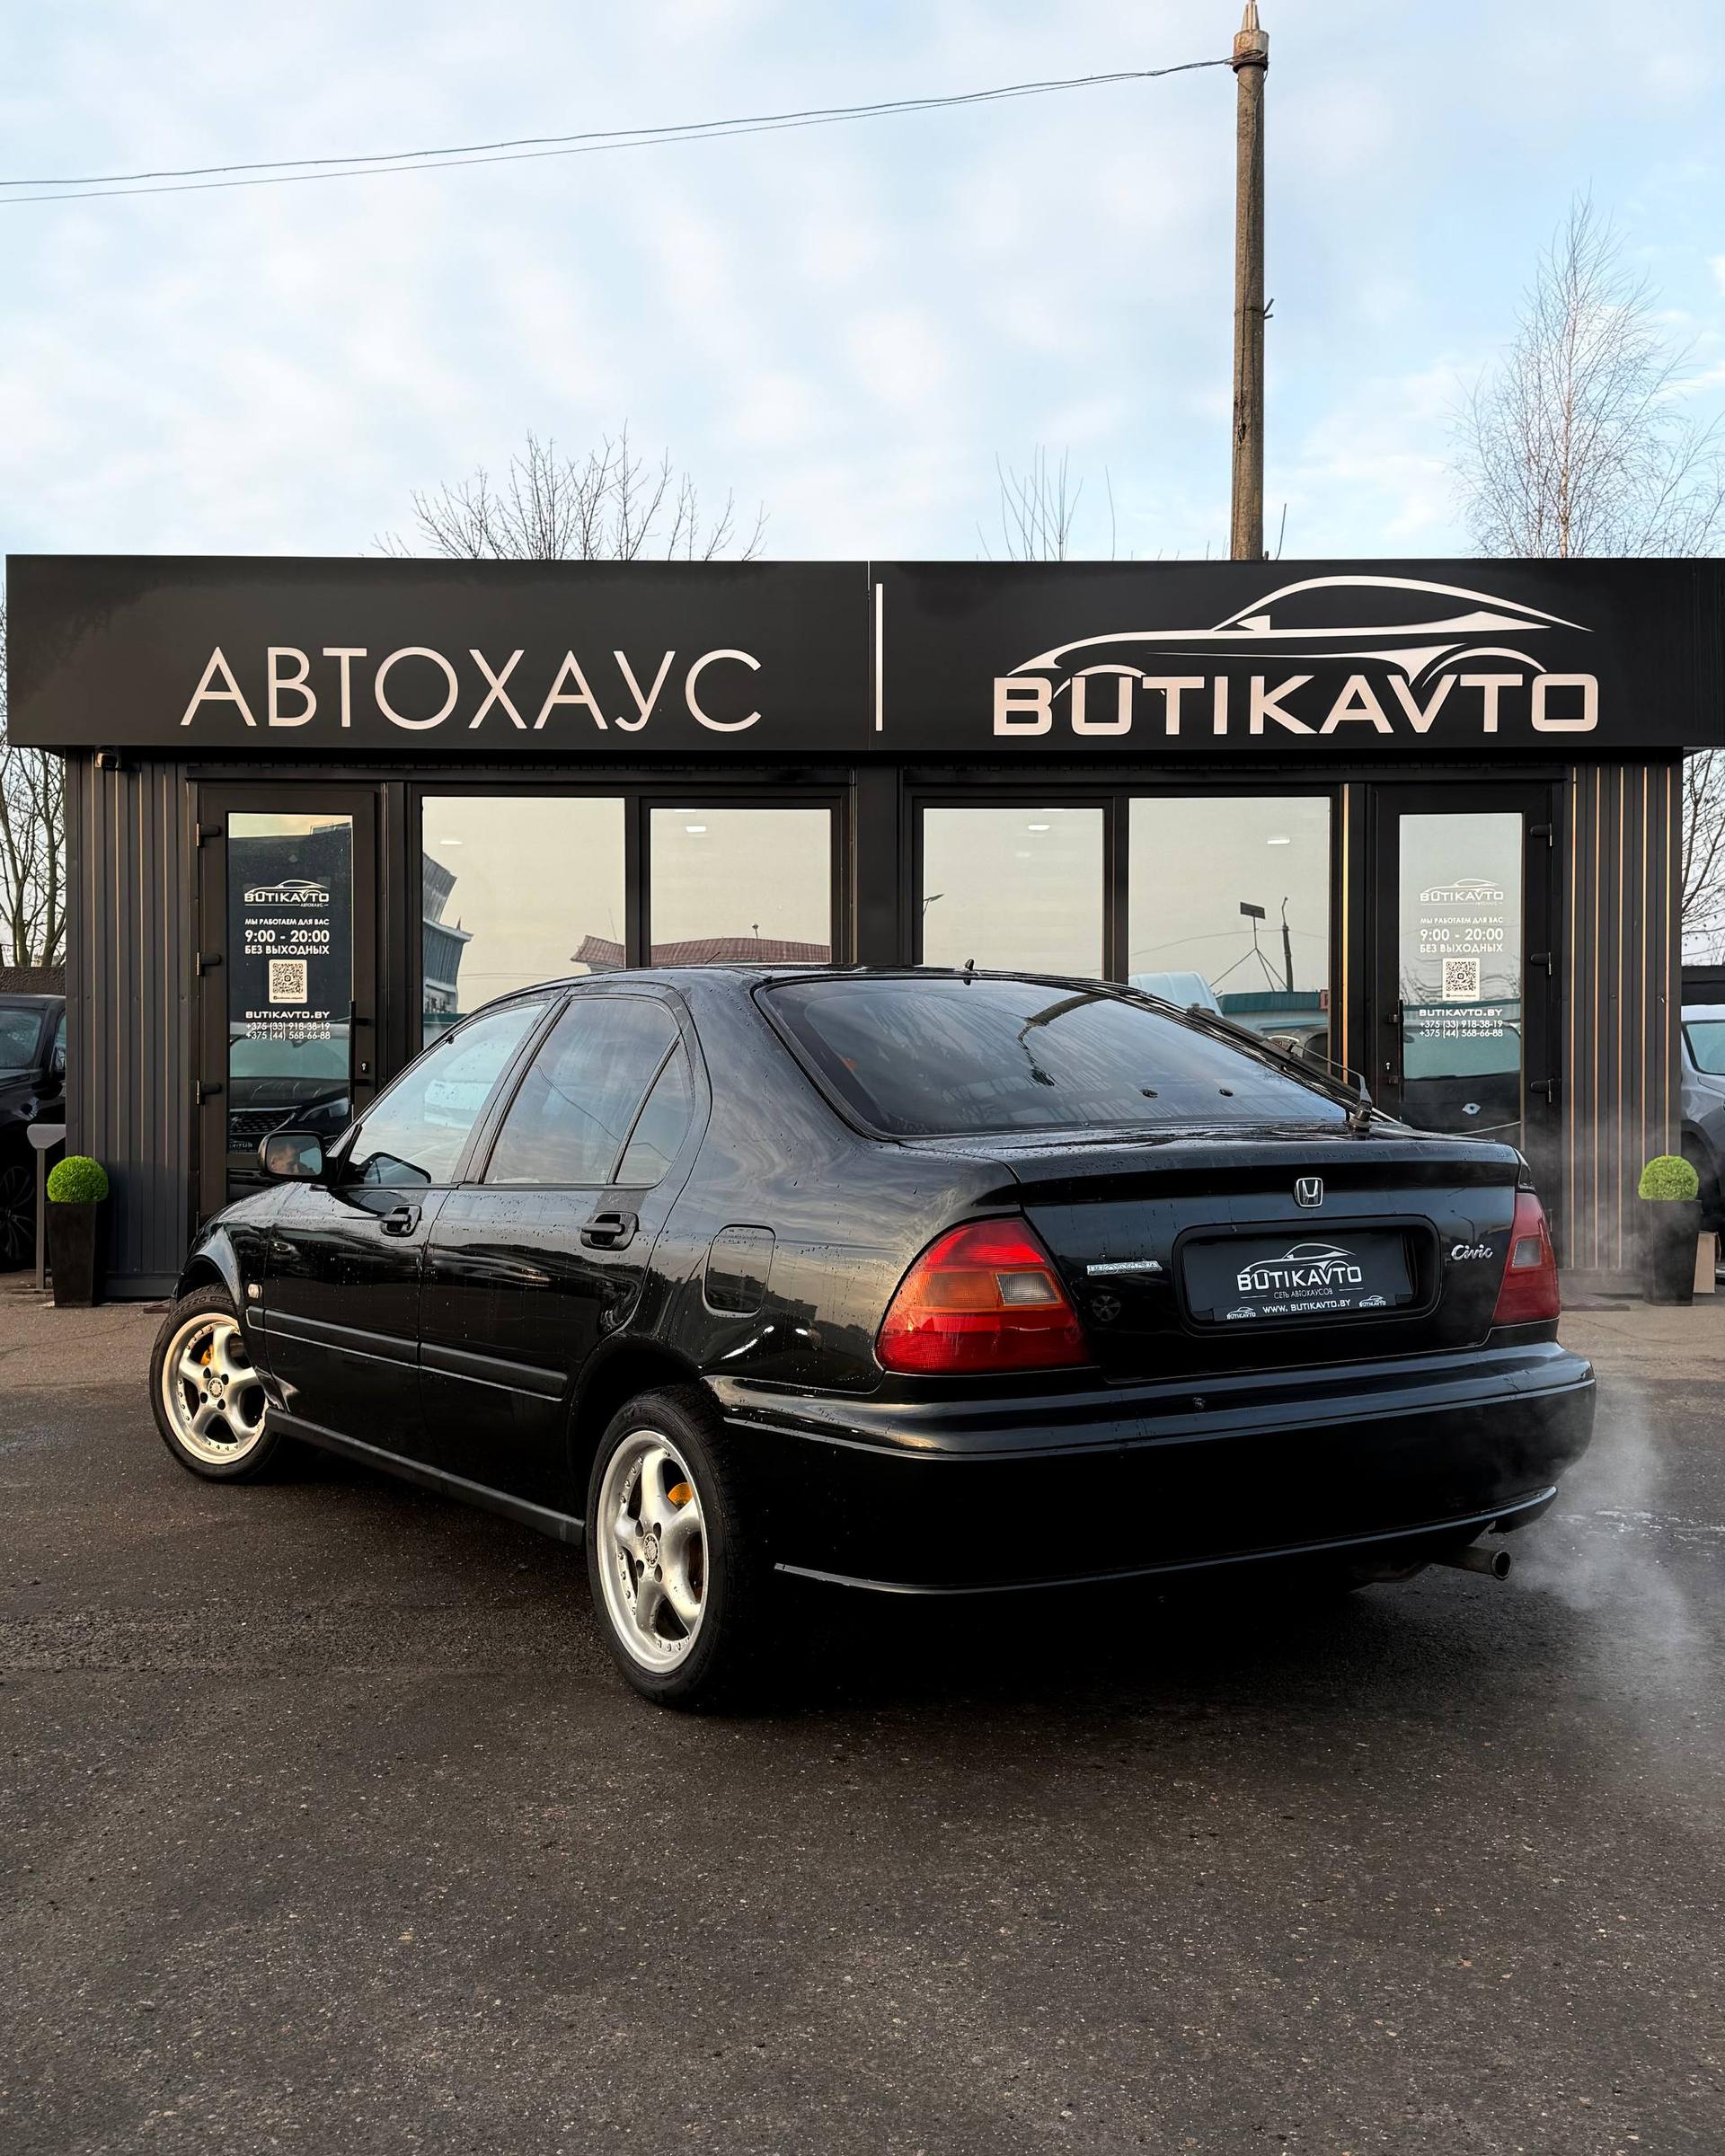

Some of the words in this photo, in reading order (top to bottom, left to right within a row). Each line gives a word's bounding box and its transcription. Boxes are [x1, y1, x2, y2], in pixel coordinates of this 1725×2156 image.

[180, 646, 763, 733] АВТОХАУС
[993, 673, 1599, 737] BUTIKAVTO
[243, 892, 330, 902] BUTIKAVTO
[1420, 891, 1504, 902] BUTIKAVTO
[297, 918, 314, 926] ДЛЯ
[244, 929, 276, 942] 9:00
[289, 929, 330, 942] 20:00
[1420, 928, 1450, 941] 9:00
[1464, 928, 1504, 941] 20:00
[244, 945, 262, 954] БЕЗ
[265, 945, 330, 955] ВЫХОДНЫХ
[1420, 944, 1437, 953] БЕЗ
[1439, 943, 1503, 953] ВЫХОДНЫХ
[245, 1011, 331, 1019] BUTIKAVTO.BY
[245, 1022, 268, 1030] +375
[270, 1022, 286, 1032] (33)
[288, 1022, 331, 1030] 918-38-19
[1443, 1020, 1459, 1030] (33)
[1461, 1020, 1503, 1029] 918-38-19
[245, 1031, 268, 1039] +375
[270, 1031, 286, 1041] (44)
[288, 1031, 331, 1039] 568-66-88
[1420, 1029, 1440, 1038] +375
[1443, 1029, 1459, 1039] (44)
[1461, 1029, 1503, 1038] 568-66-88
[1451, 1243, 1493, 1261] Civic
[1236, 1266, 1362, 1292] BUTIKAVTO
[1273, 1291, 1290, 1300] СЕТЬ
[1290, 1287, 1333, 1298] АВТОХАУСОВ
[1262, 1303, 1288, 1313] WWW.
[1290, 1299, 1351, 1312] BUTIKAVTO.BY
